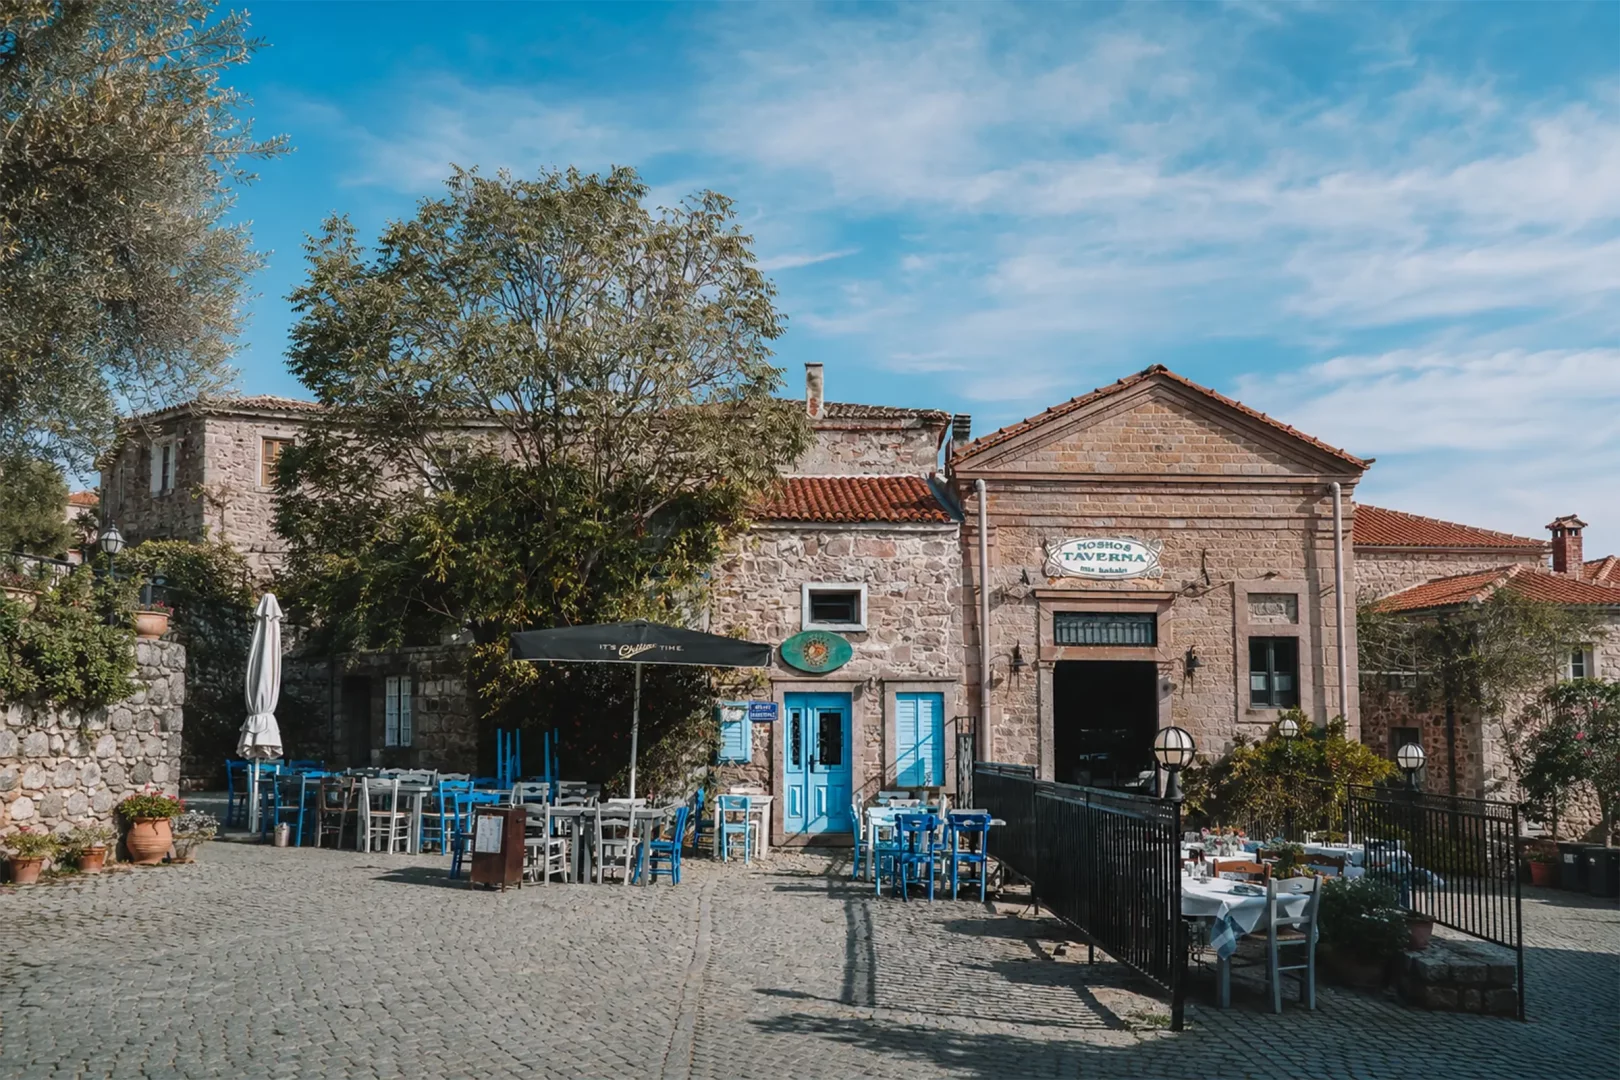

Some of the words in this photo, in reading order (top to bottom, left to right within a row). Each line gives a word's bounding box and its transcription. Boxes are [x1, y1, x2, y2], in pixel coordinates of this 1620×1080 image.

[1077, 541, 1131, 552] MOSHOS
[1063, 552, 1146, 562] TAVERNA
[599, 643, 617, 651] IT'S
